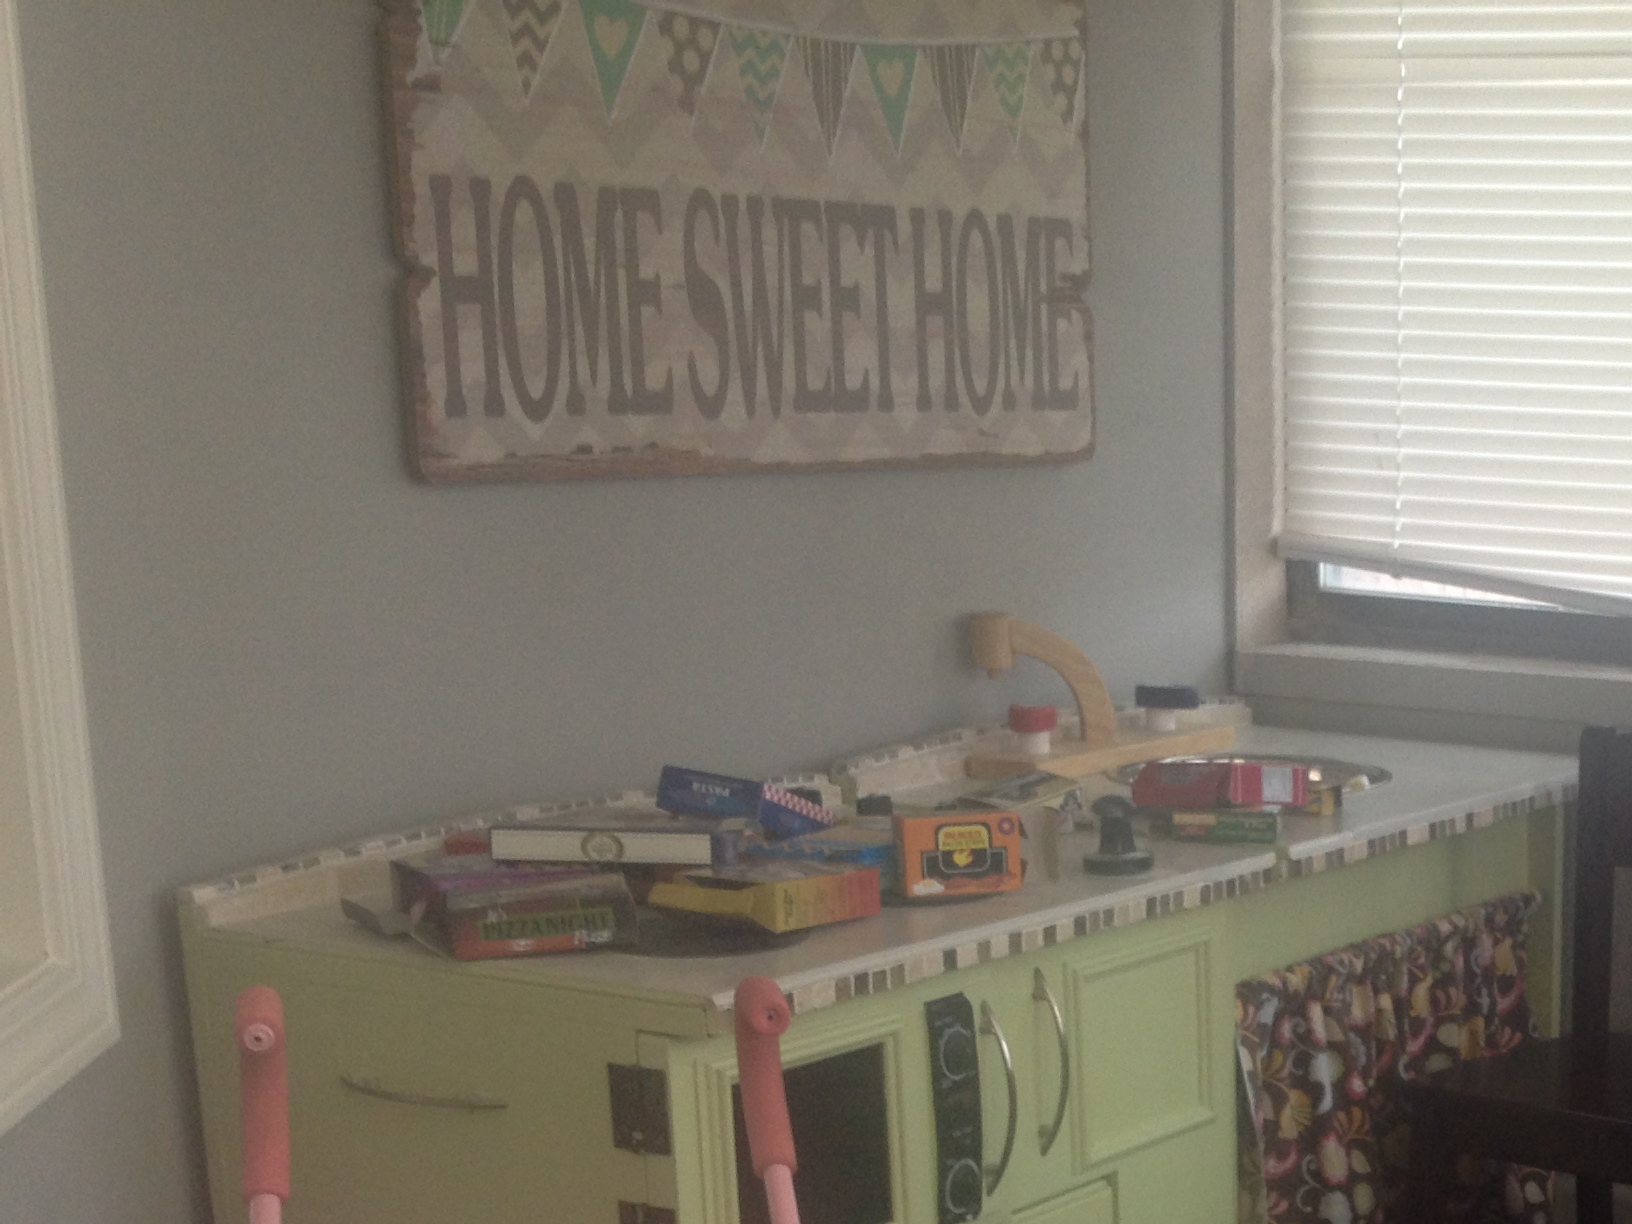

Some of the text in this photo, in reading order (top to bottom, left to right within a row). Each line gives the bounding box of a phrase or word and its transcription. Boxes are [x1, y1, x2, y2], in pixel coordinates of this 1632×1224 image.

[428, 174, 1081, 423] HOME SWEET HOME
[692, 781, 731, 798] PASTA
